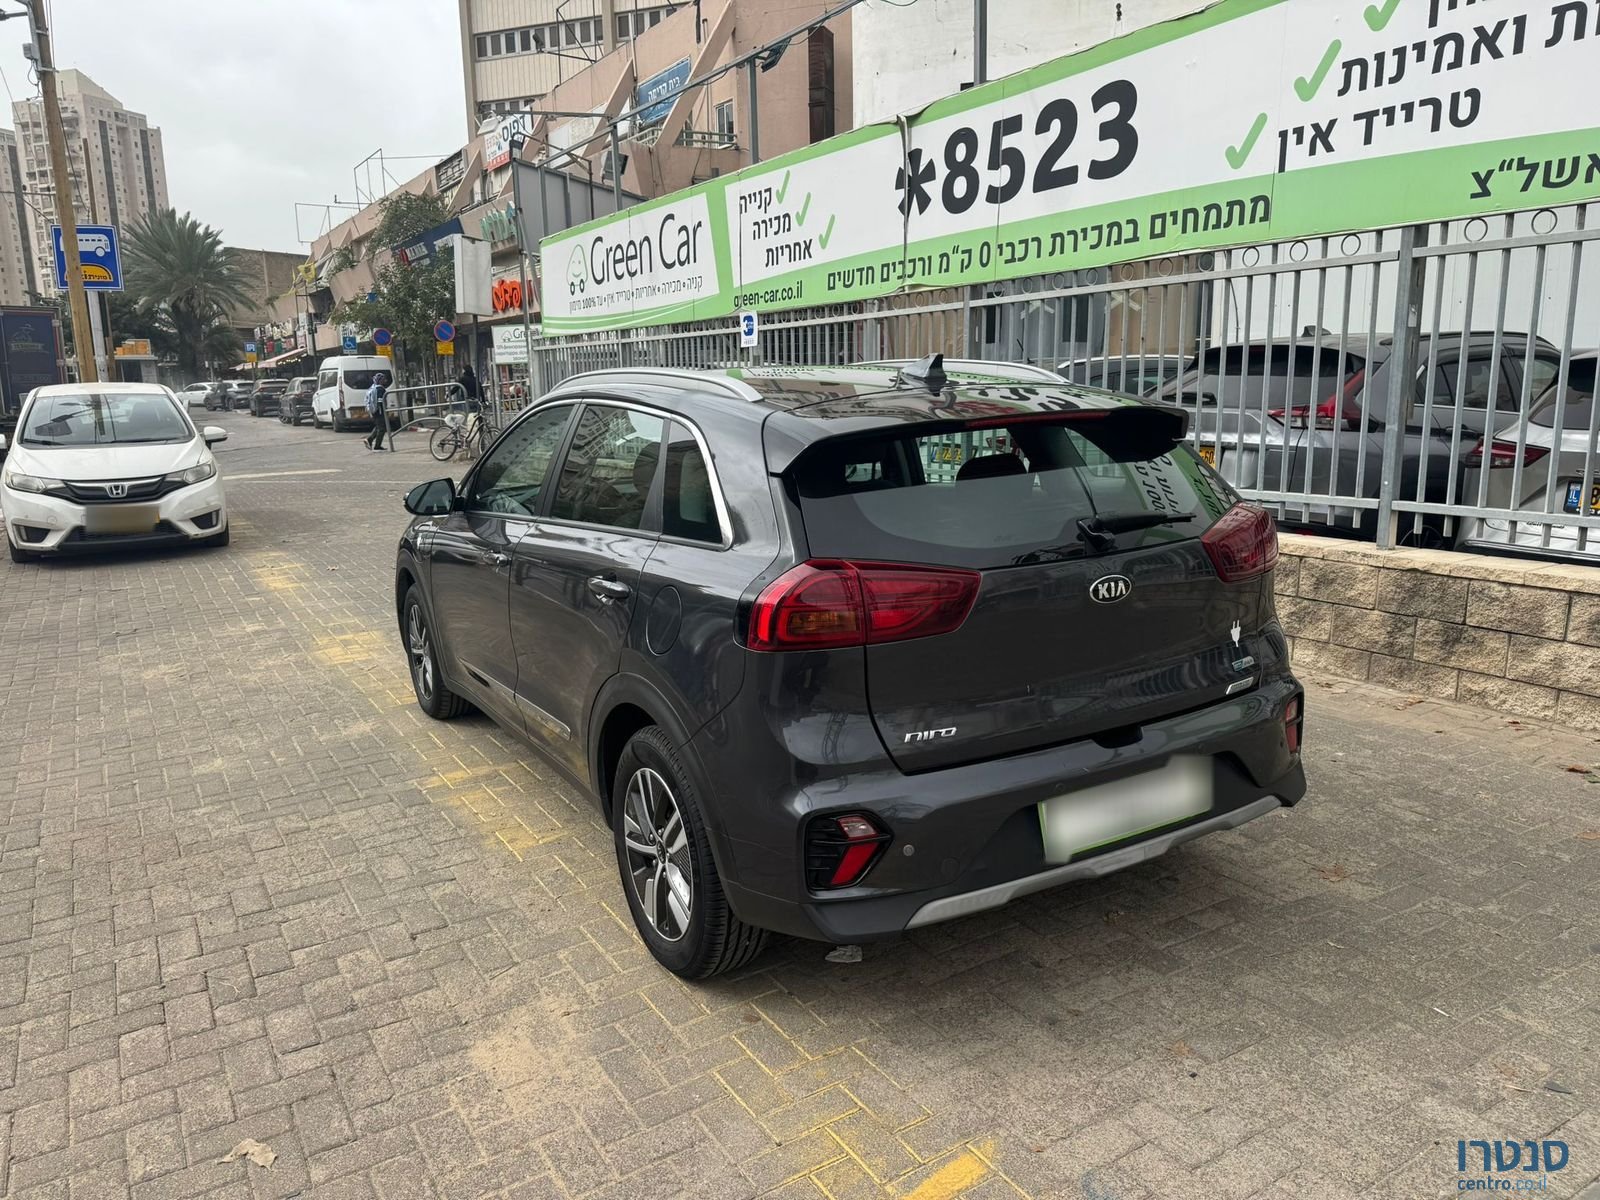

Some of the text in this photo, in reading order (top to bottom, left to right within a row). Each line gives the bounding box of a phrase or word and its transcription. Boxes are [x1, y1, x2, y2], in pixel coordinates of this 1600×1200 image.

[1337, 14, 1527, 97] ואמינות
[668, 76, 681, 92] בית
[1278, 87, 1482, 174] טרייד אין
[739, 187, 772, 214] קנייה
[753, 212, 791, 241] מכירה
[1149, 194, 1270, 240] מתמחים
[590, 213, 702, 285] Green Car
[998, 236, 1042, 264] רכבי
[1049, 218, 1140, 257] במכירת
[765, 238, 813, 268] אחריות
[827, 265, 875, 290] חדשים
[880, 255, 932, 282] ורכבים
[661, 280, 682, 295] מכירה
[734, 280, 803, 308] geen-car.co.il
[1097, 581, 1127, 600] KIA
[904, 726, 957, 743] niro
